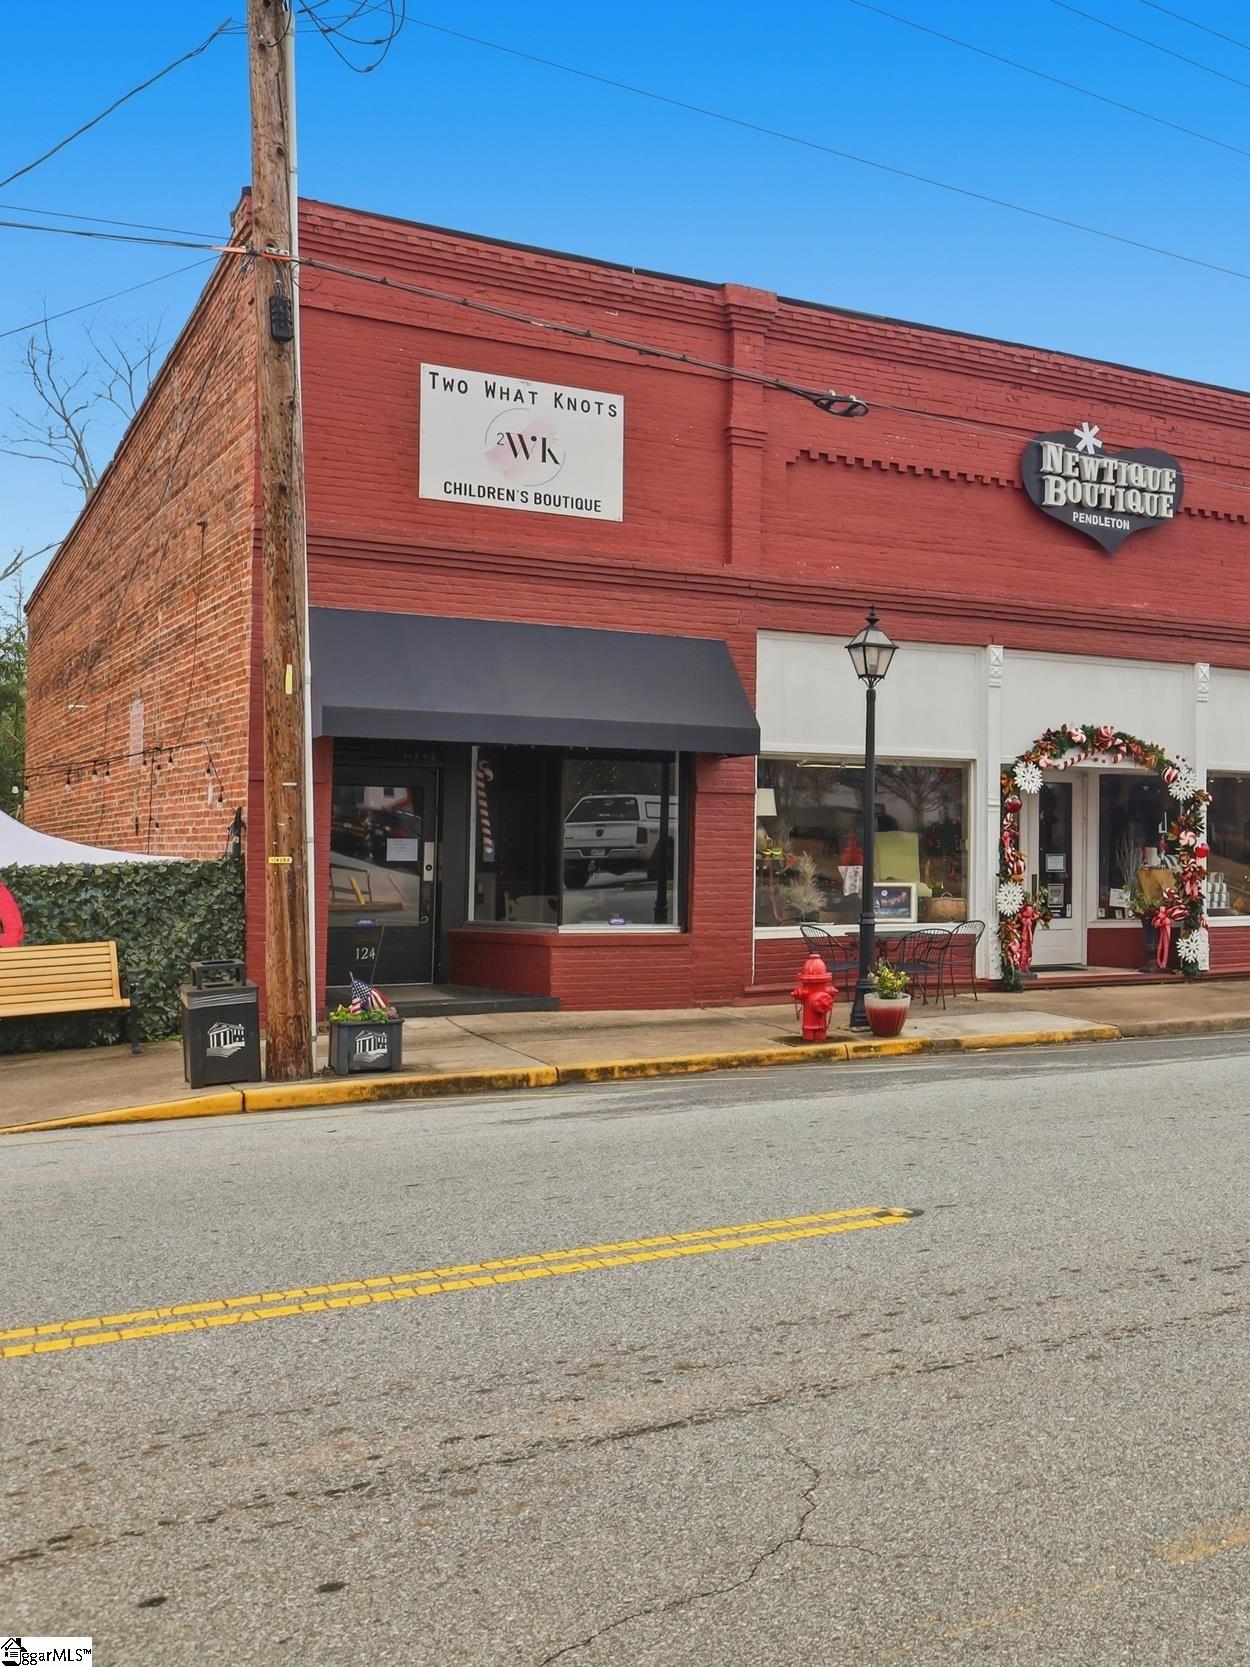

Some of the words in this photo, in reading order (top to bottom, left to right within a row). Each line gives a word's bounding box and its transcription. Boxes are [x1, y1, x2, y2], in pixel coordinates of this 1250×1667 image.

[428, 371, 468, 394] TWO
[485, 380, 538, 405] WHAT
[554, 391, 618, 418] KNOTS
[1040, 441, 1176, 493] NEWTIQUE
[443, 480, 529, 504] CHILDREN'S
[534, 492, 602, 513] BOUTIQUE
[1042, 475, 1174, 518] BOUTIQUE
[1073, 512, 1130, 530] PENDLETON
[356, 947, 375, 960] 124
